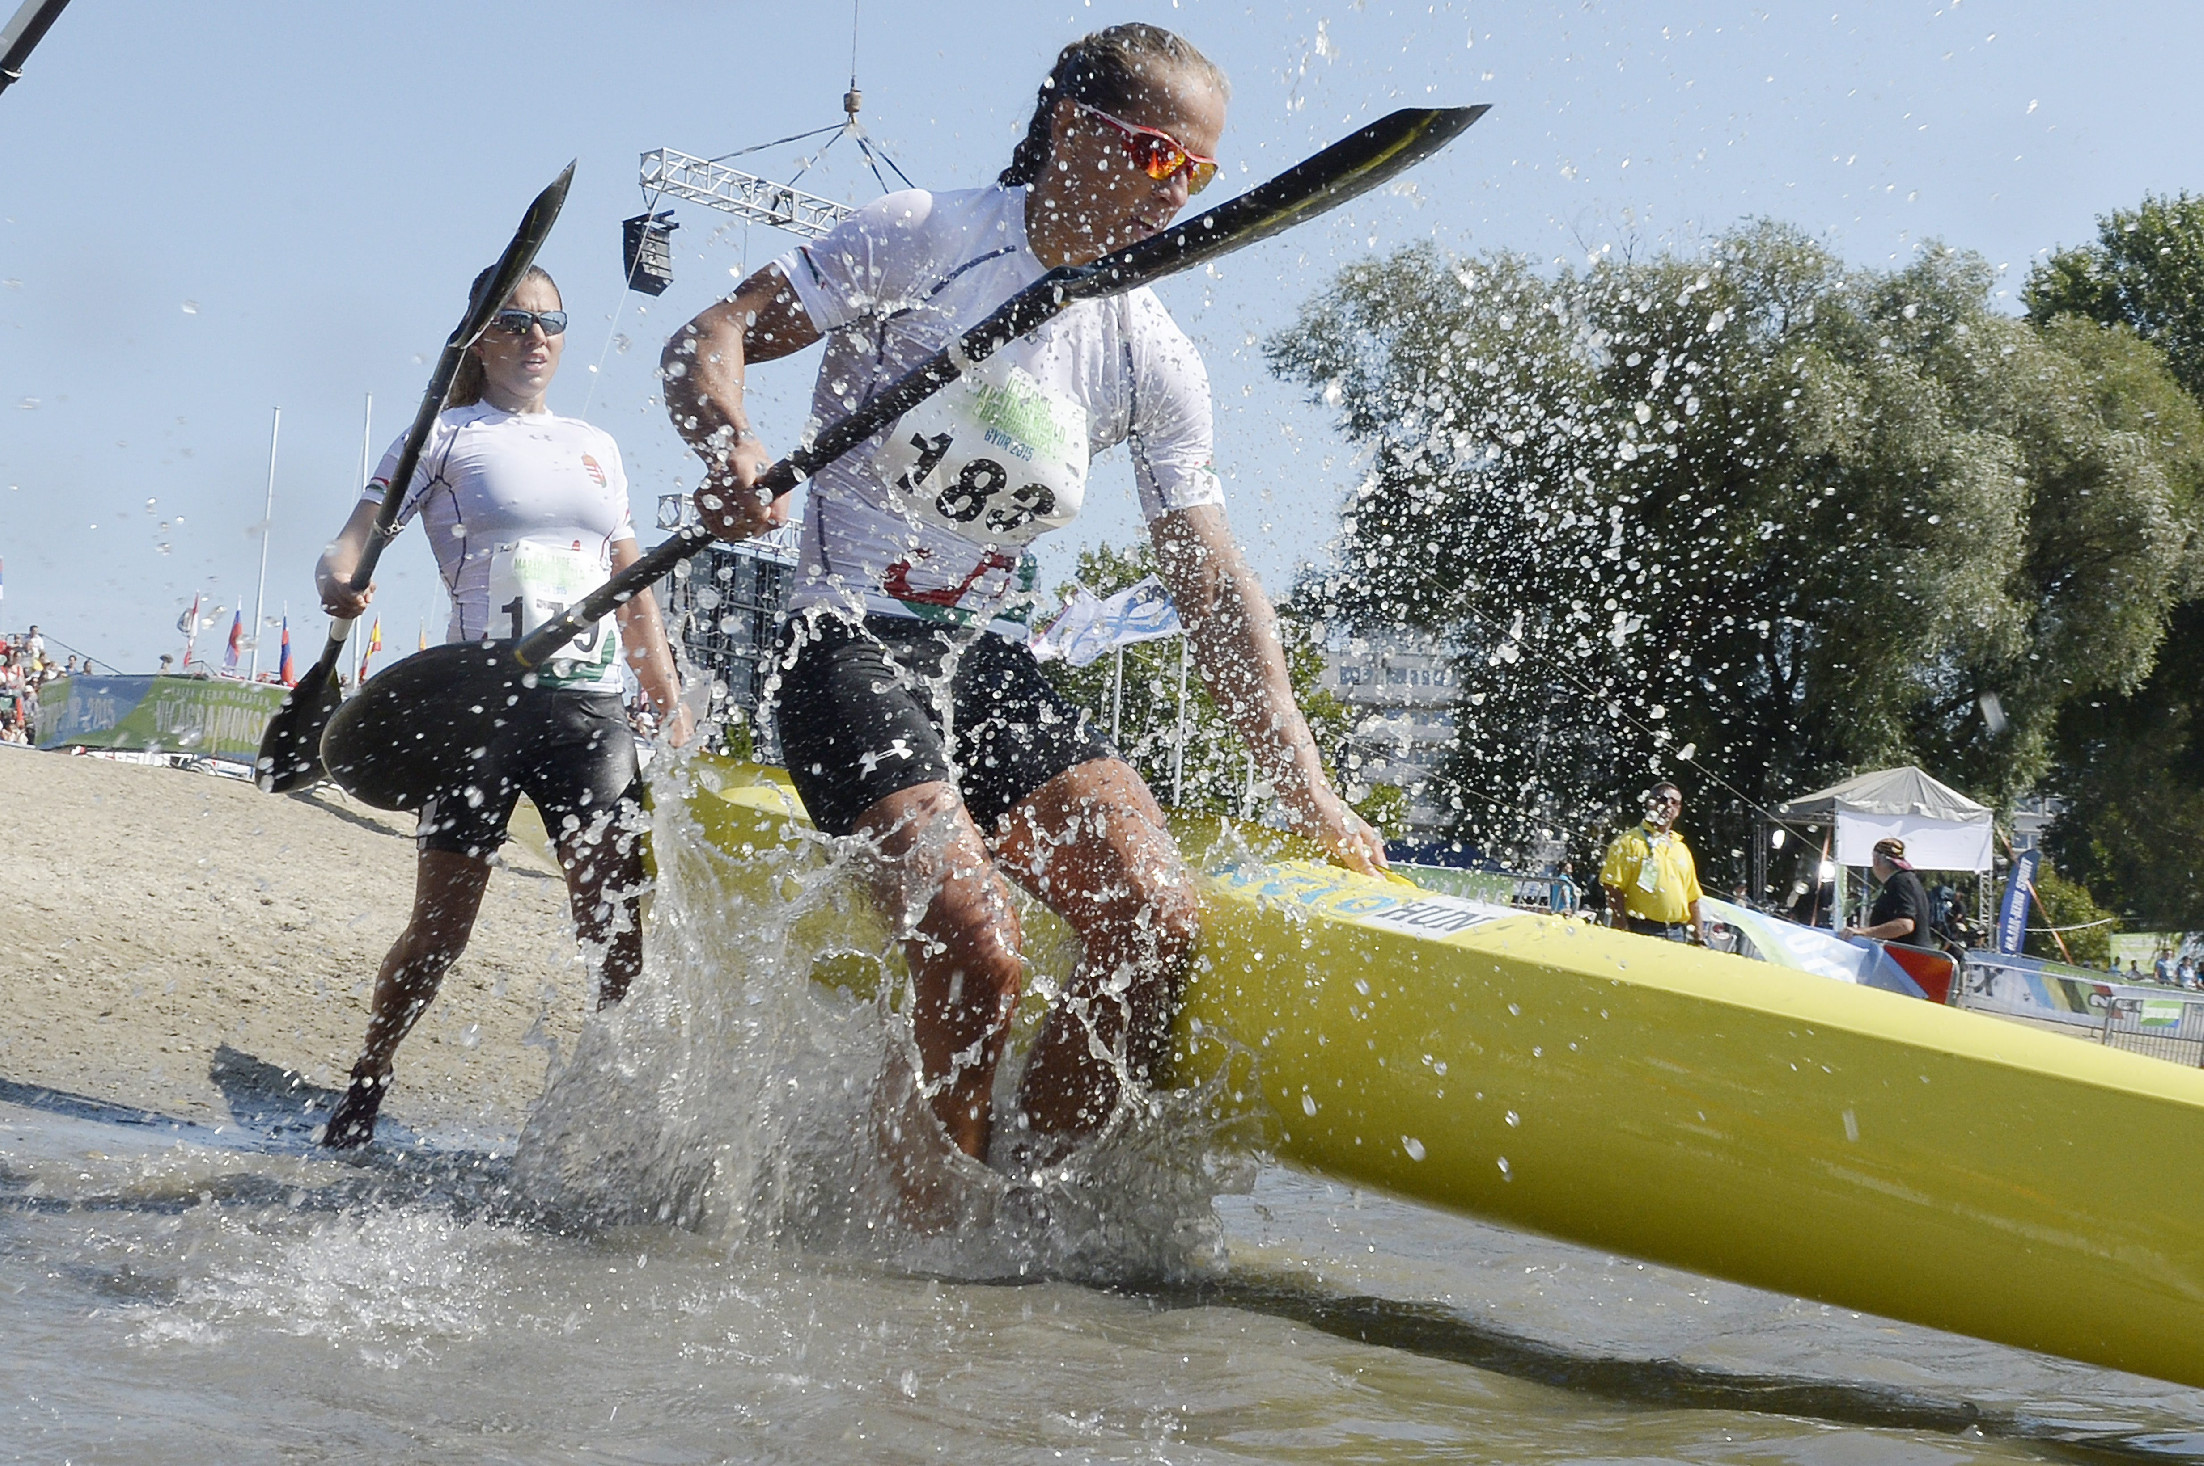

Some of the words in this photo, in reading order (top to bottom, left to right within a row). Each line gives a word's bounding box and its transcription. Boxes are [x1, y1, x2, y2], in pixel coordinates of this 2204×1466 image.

[896, 432, 1055, 532] 183
[2015, 856, 2034, 892] SPORT
[1374, 902, 1497, 931] HUN
